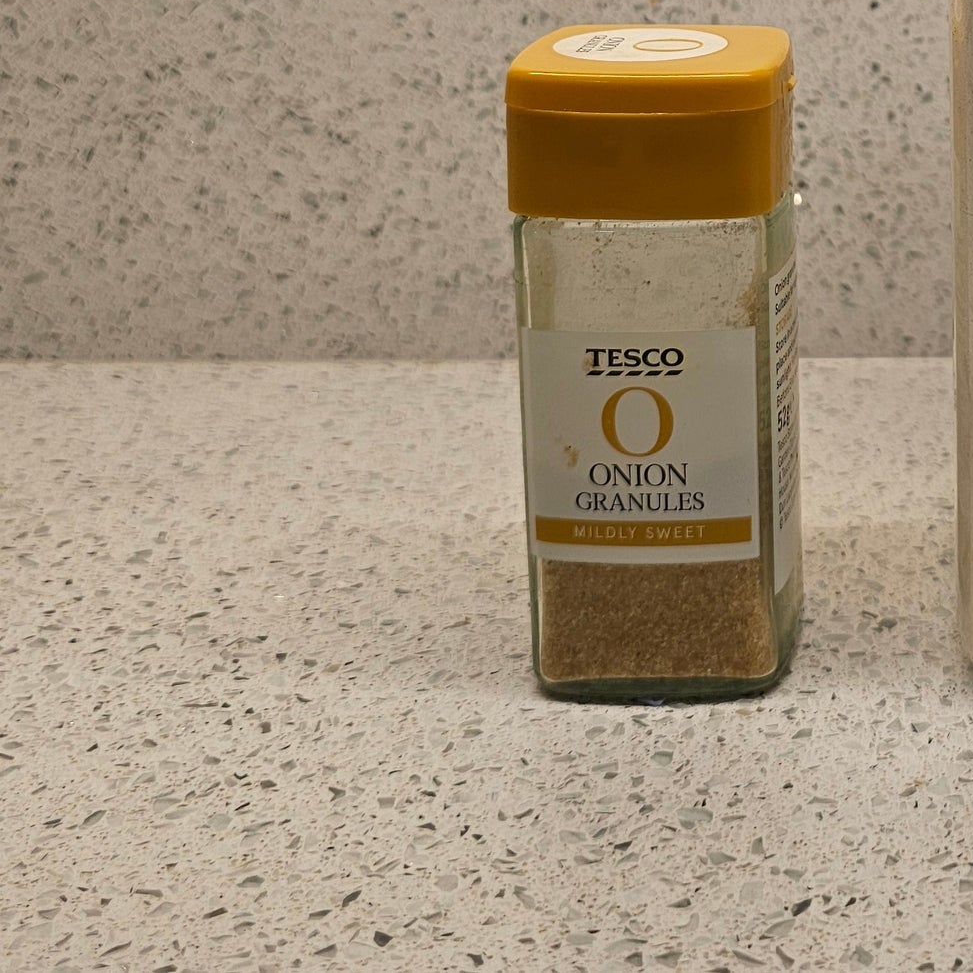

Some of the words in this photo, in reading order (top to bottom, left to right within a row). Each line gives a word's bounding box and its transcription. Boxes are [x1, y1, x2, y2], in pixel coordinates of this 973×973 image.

[586, 347, 685, 368] TESCO
[601, 386, 675, 458] O
[589, 463, 689, 487] ONION
[575, 491, 706, 512] GRANULES
[574, 525, 638, 539] MILDLY
[645, 525, 706, 539] SWEET
